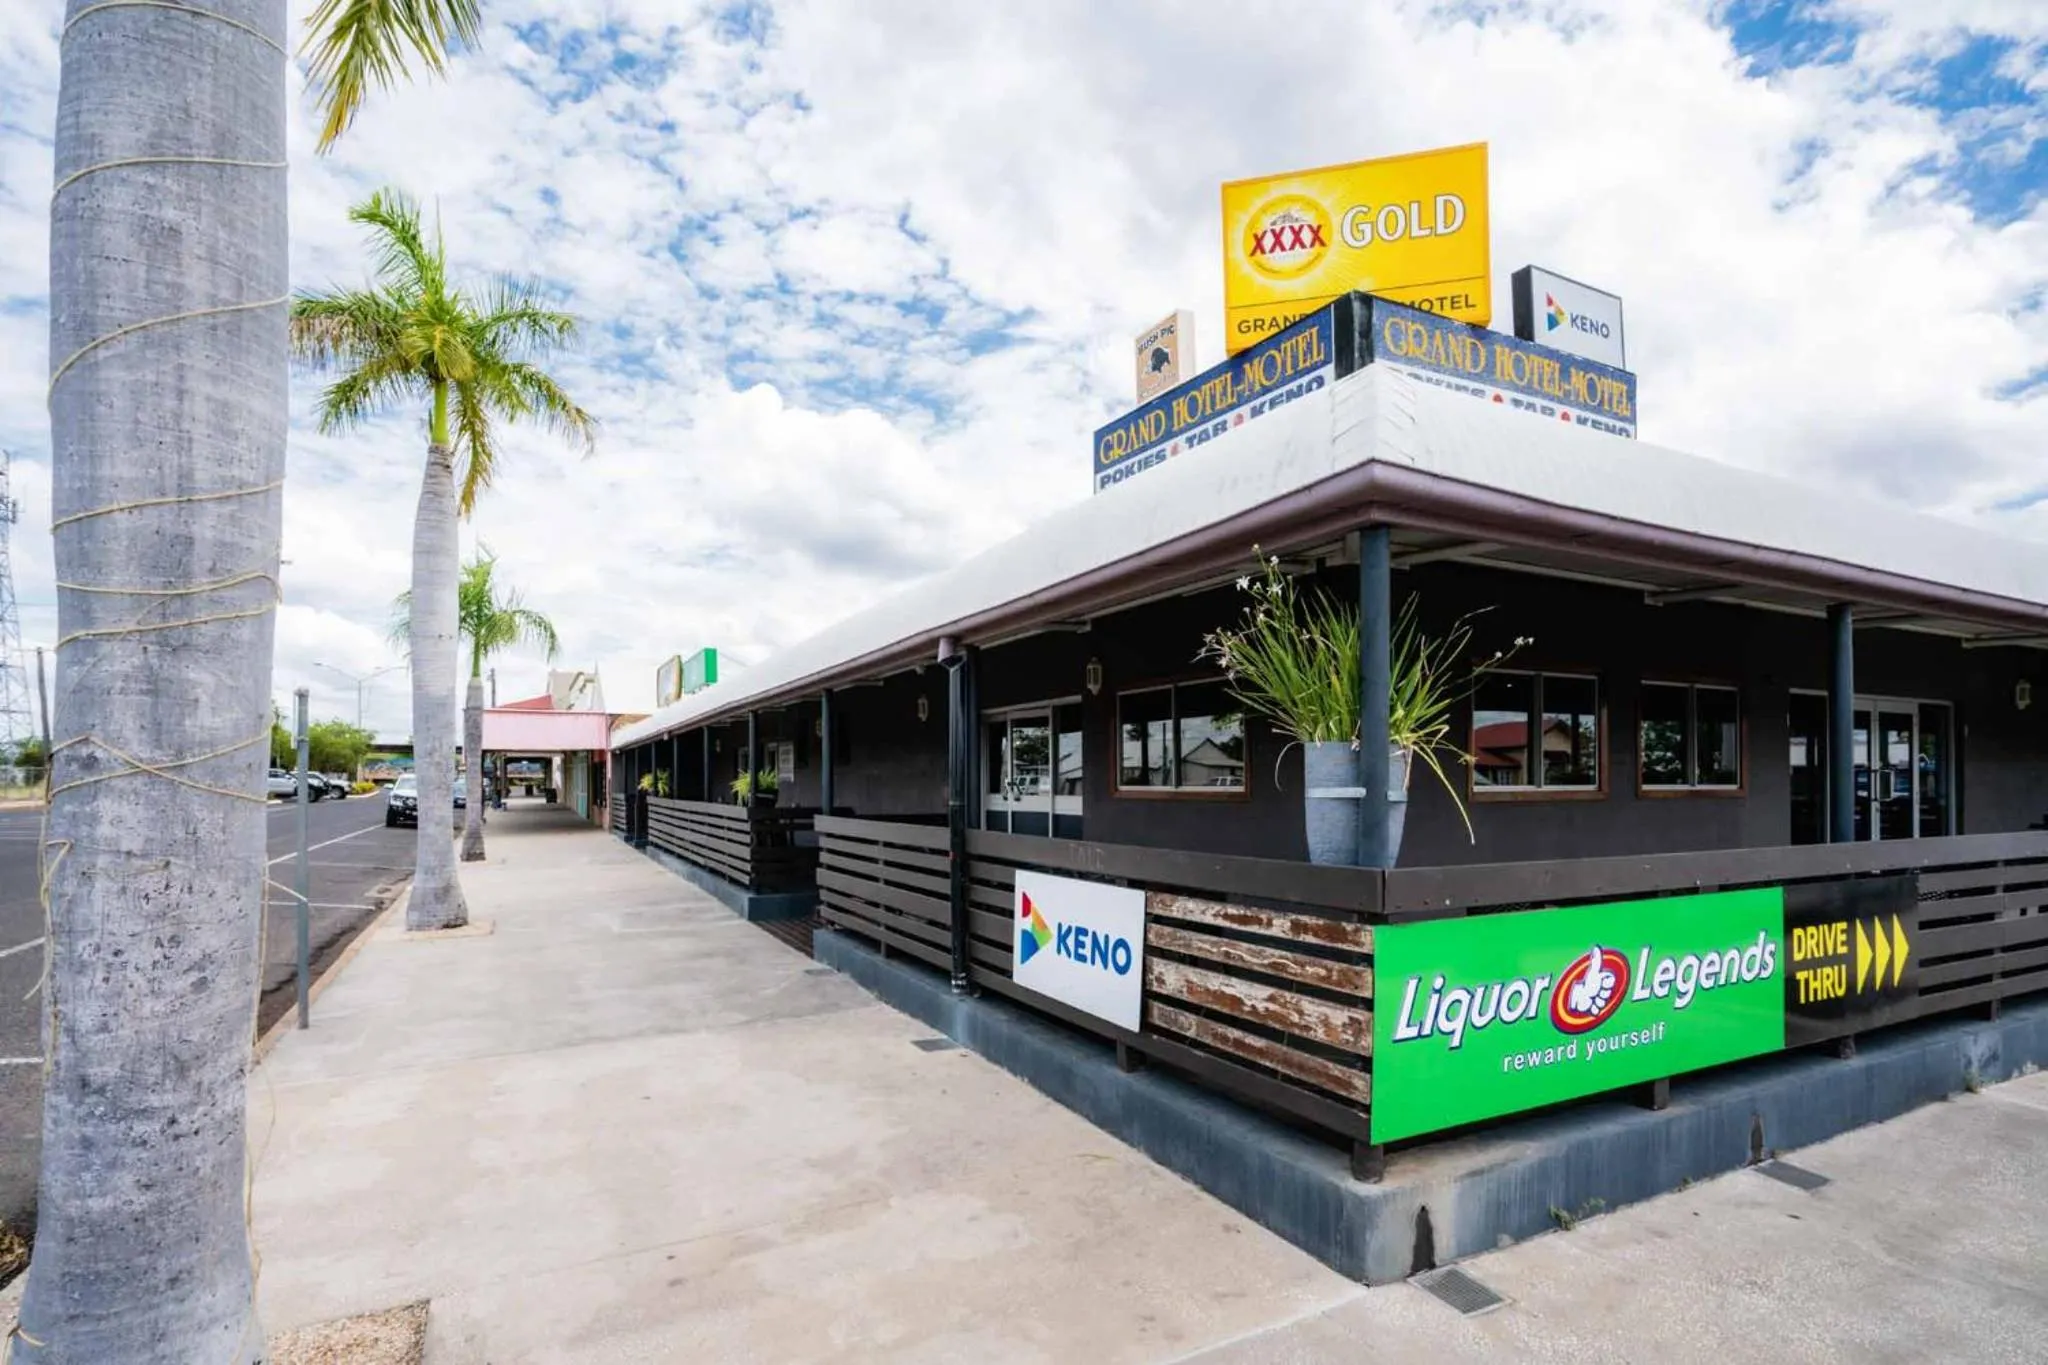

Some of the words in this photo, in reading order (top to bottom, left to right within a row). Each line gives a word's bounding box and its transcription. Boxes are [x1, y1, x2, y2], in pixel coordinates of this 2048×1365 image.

[1250, 223, 1327, 257] XXXX
[1342, 193, 1466, 249] GOLD
[1569, 312, 1610, 339] KENO
[1100, 409, 1166, 464] GRAND
[1172, 327, 1325, 432] HOTEL-MOTEL
[1384, 317, 1487, 374] GRAND
[1494, 345, 1631, 417] HOTEL-MOTEL
[1100, 448, 1167, 489] POKIES
[1250, 375, 1325, 419] KENO
[1056, 922, 1132, 976] KENO
[1793, 921, 1848, 961] DRIVE
[1393, 972, 1552, 1051] Liquor
[1631, 929, 1777, 1008] Legends
[1796, 964, 1847, 1005] THRU
[1503, 1040, 1577, 1073] reward
[1586, 1022, 1665, 1060] yourself
